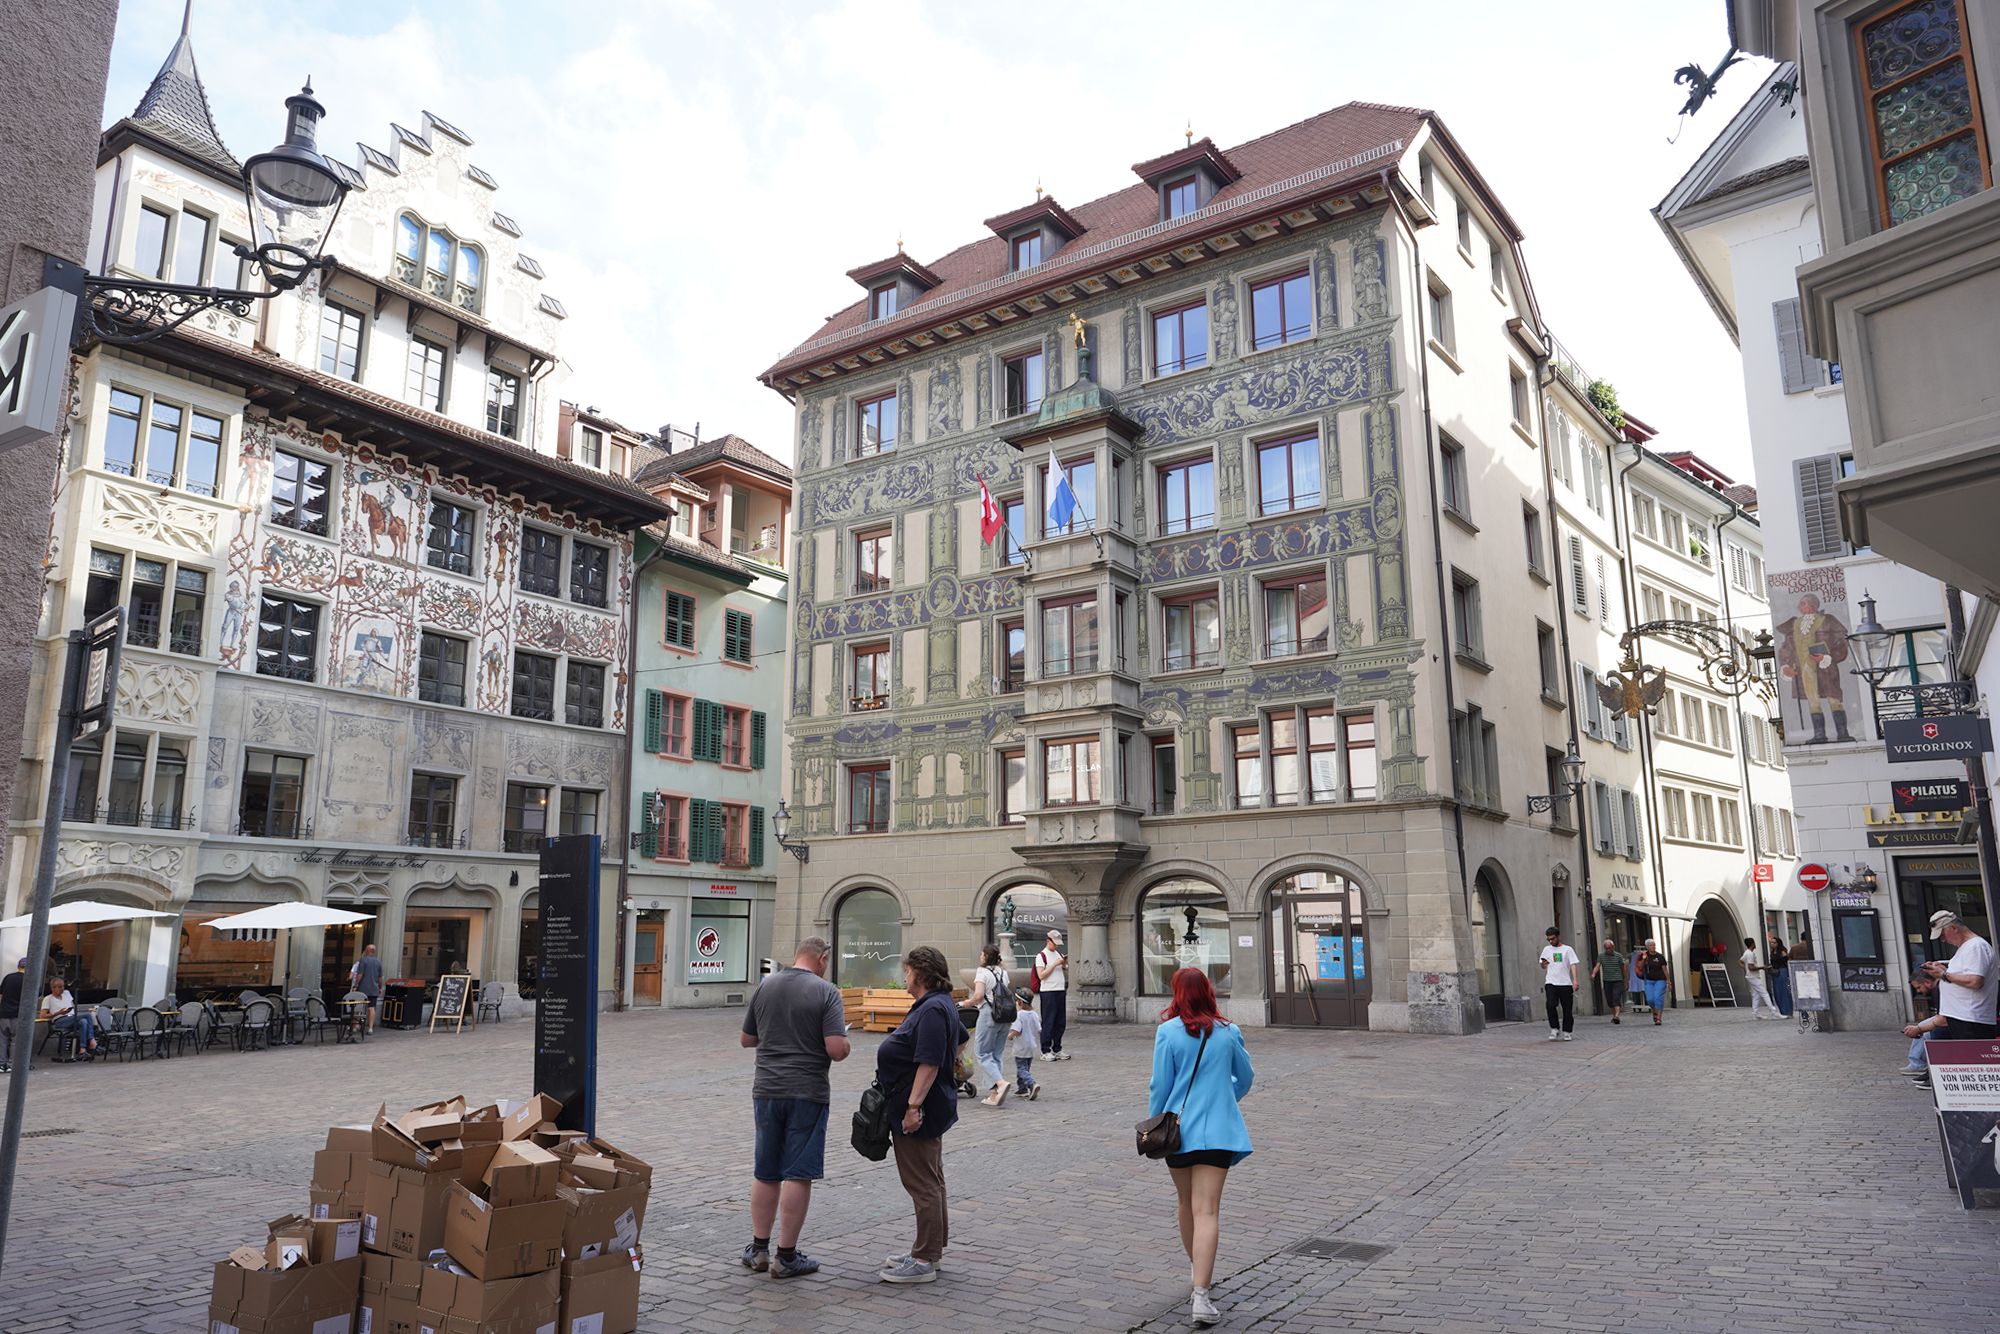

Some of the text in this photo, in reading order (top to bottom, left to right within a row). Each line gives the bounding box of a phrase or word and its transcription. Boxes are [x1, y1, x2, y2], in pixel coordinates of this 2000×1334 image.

[1788, 572, 1844, 588] GOETHE
[1823, 587, 1846, 598] HIER
[1824, 594, 1846, 603] 1779
[1894, 740, 1973, 753] VICTORINOX
[1910, 784, 1957, 796] PILATUS
[1863, 804, 1905, 825] LA
[1892, 832, 1958, 843] STEAKHOUS
[399, 853, 429, 869] Fred
[1907, 863, 1937, 871] PIZZA
[1611, 873, 1640, 891] ANOUK
[1831, 898, 1868, 907] TERRASSE
[689, 960, 725, 968] MAMMUT
[1858, 967, 1884, 975] PIZZA
[1843, 982, 1875, 991] BURGER
[1941, 1074, 1957, 1082] VON
[1960, 1074, 1976, 1082] UNS
[1943, 1083, 1959, 1091] VON
[1962, 1083, 1986, 1091] IHNEN
